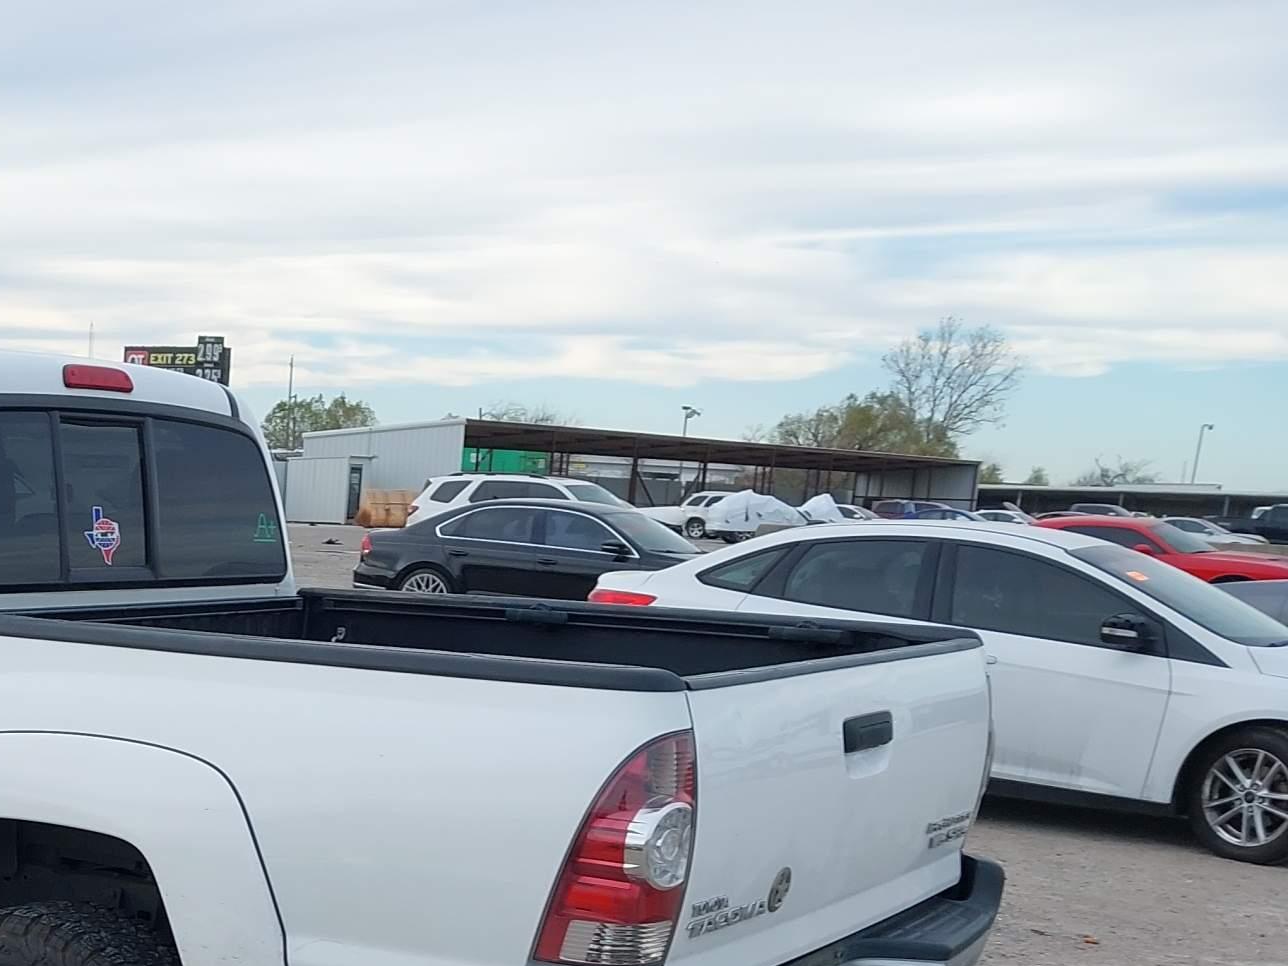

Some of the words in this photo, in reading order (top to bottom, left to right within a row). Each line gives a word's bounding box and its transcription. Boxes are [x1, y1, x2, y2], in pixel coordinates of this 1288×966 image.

[150, 353, 174, 364] EXIT
[174, 353, 196, 364] 273
[686, 900, 766, 938] TACOMA
